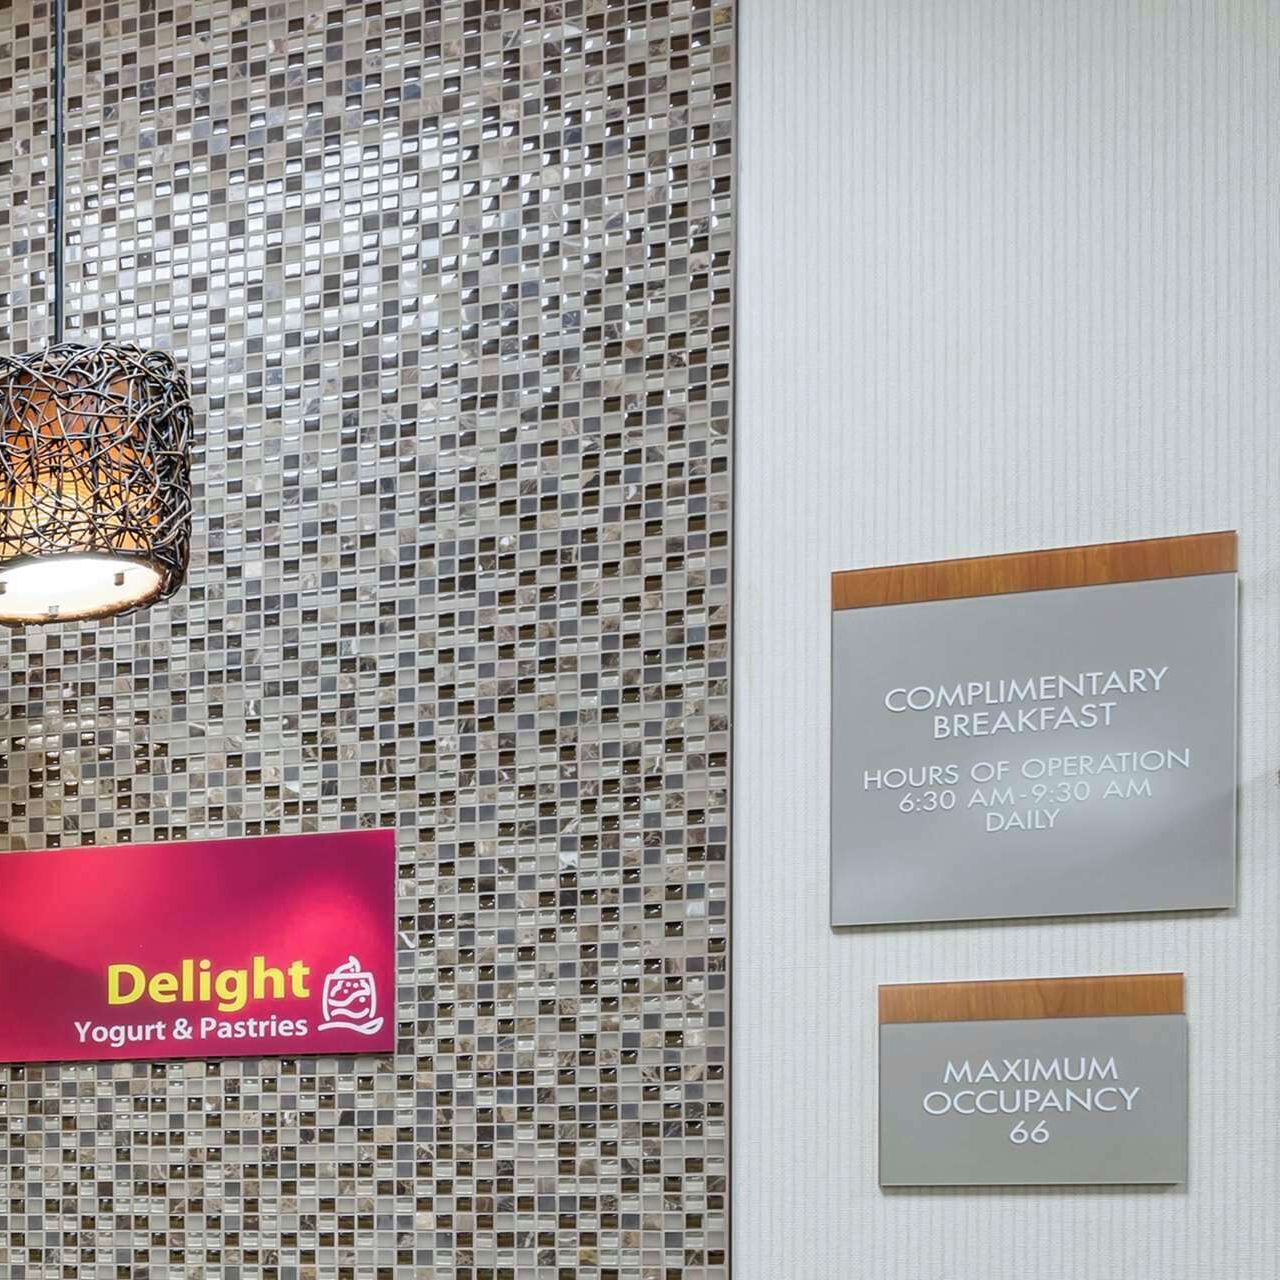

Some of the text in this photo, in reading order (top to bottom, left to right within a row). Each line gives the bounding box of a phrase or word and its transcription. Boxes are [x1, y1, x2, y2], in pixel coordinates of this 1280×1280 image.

[885, 667, 1169, 713] COMPLIMENTARY
[933, 702, 1117, 739] BREAKFAST
[863, 748, 1190, 790] HOURS OF OPERATION
[899, 790, 956, 812] 6:30
[1103, 778, 1152, 799] AM
[986, 809, 1060, 832] DAILY
[107, 956, 310, 1013] Delight
[74, 1014, 308, 1047] Yogurt & Pastries
[943, 1056, 1119, 1083] MAXIMUM
[923, 1087, 1140, 1115] OCCUPANCY
[1009, 1120, 1050, 1144] 66
